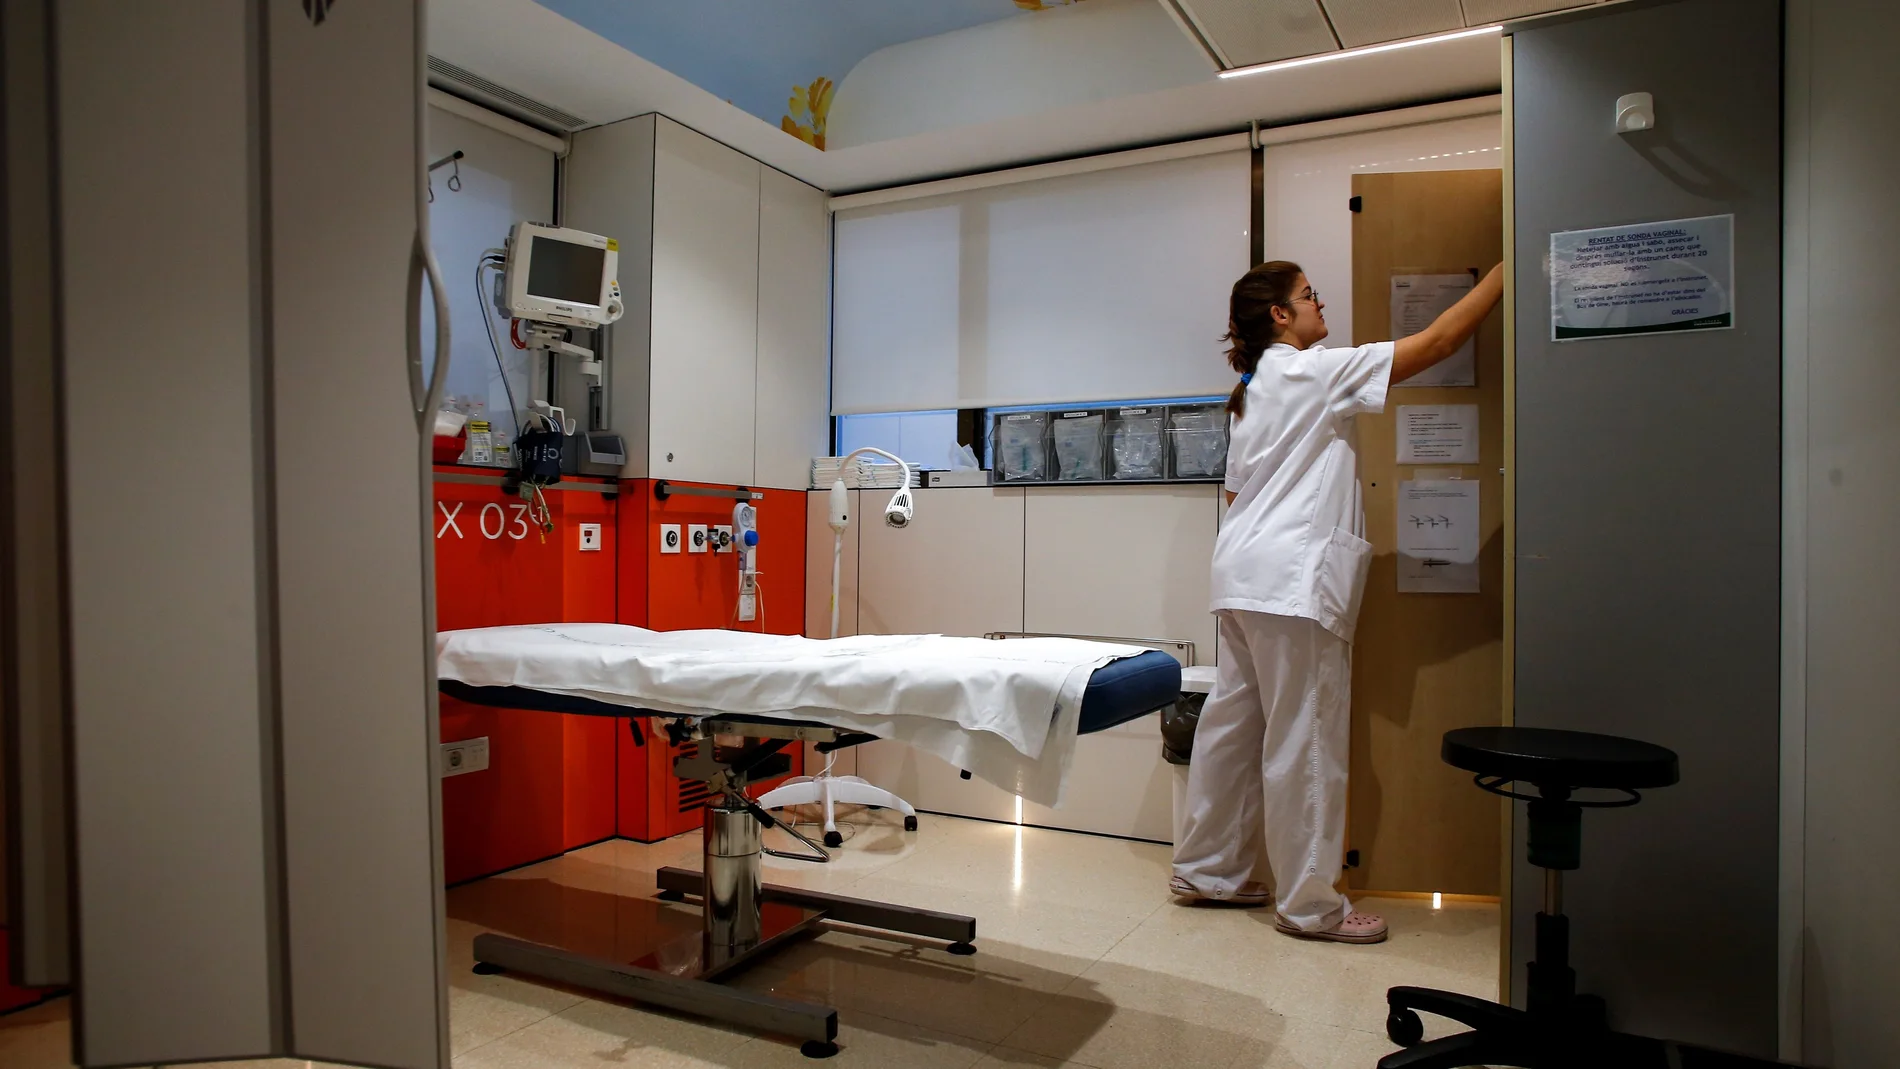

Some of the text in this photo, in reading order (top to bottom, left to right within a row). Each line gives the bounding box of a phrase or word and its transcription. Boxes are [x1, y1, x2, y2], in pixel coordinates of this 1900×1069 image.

[1588, 236, 1614, 245] RENTAT
[1627, 232, 1652, 241] SONDA
[1653, 229, 1687, 238] VAGINAL:
[1604, 243, 1620, 251] amb
[1621, 241, 1640, 249] aigua
[1667, 236, 1694, 244] assecar
[1671, 251, 1696, 259] durant
[480, 503, 528, 540] 03
